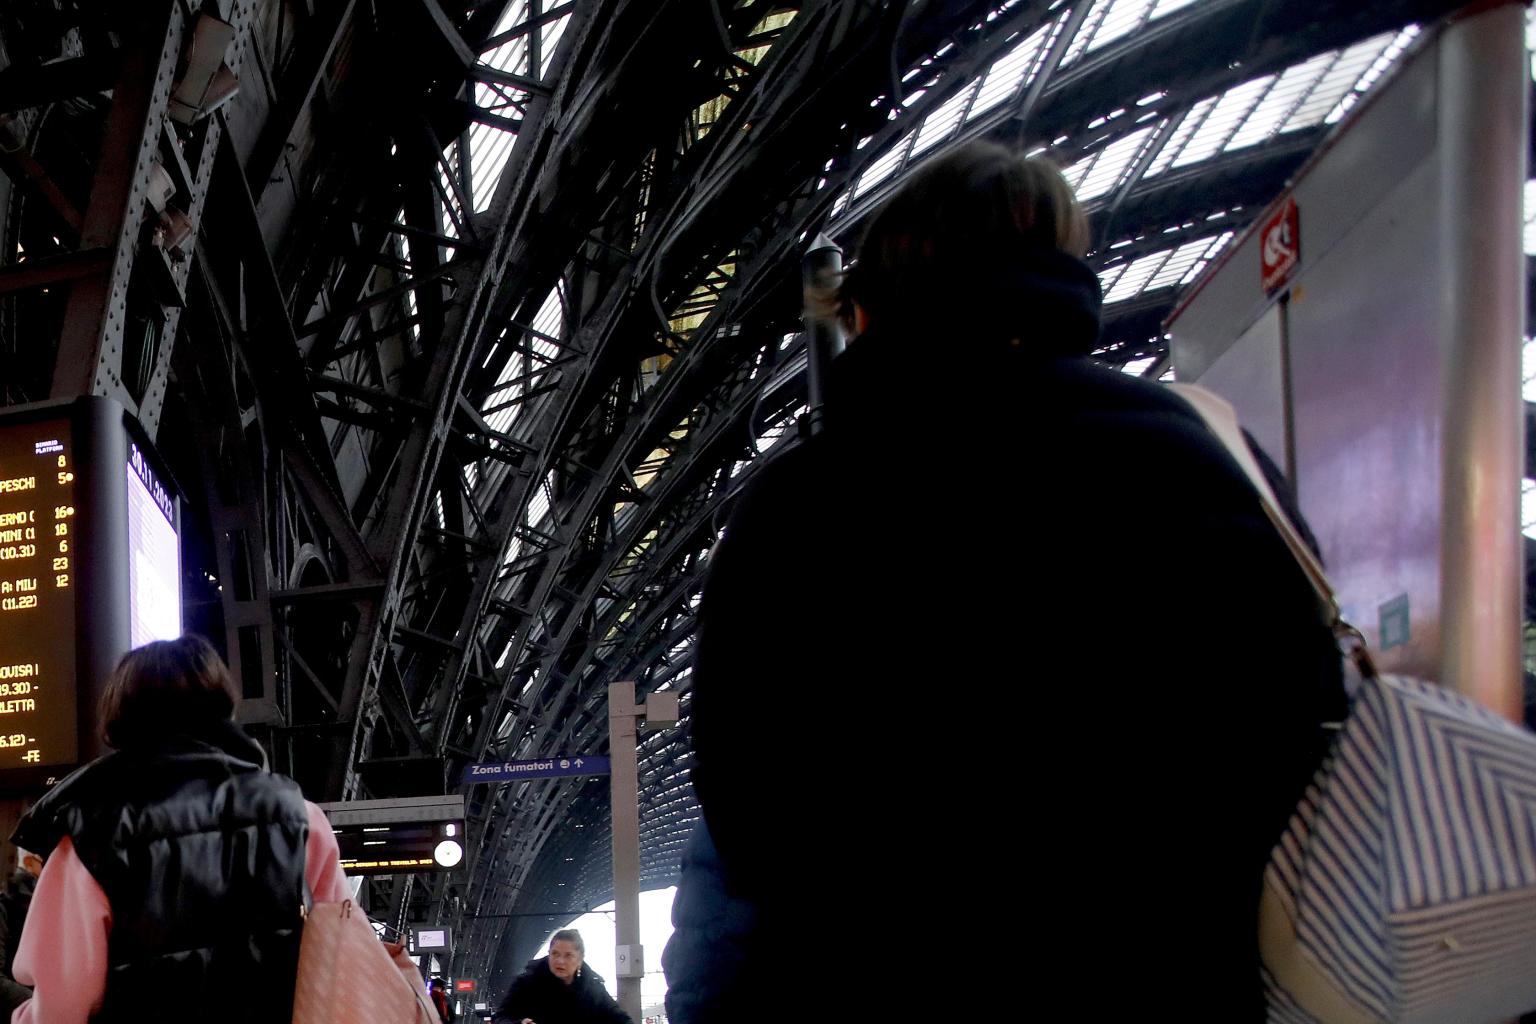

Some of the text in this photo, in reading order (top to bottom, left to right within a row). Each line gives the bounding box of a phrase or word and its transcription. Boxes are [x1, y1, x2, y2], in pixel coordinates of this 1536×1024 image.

[55, 506, 67, 519] 16
[55, 523, 68, 536] 18
[0, 544, 36, 560] (10.31)
[54, 557, 69, 571] 23
[57, 574, 69, 588] 12
[3, 595, 37, 611] (11.22)
[472, 760, 554, 775] Zona fumatori
[619, 954, 626, 964] 9
